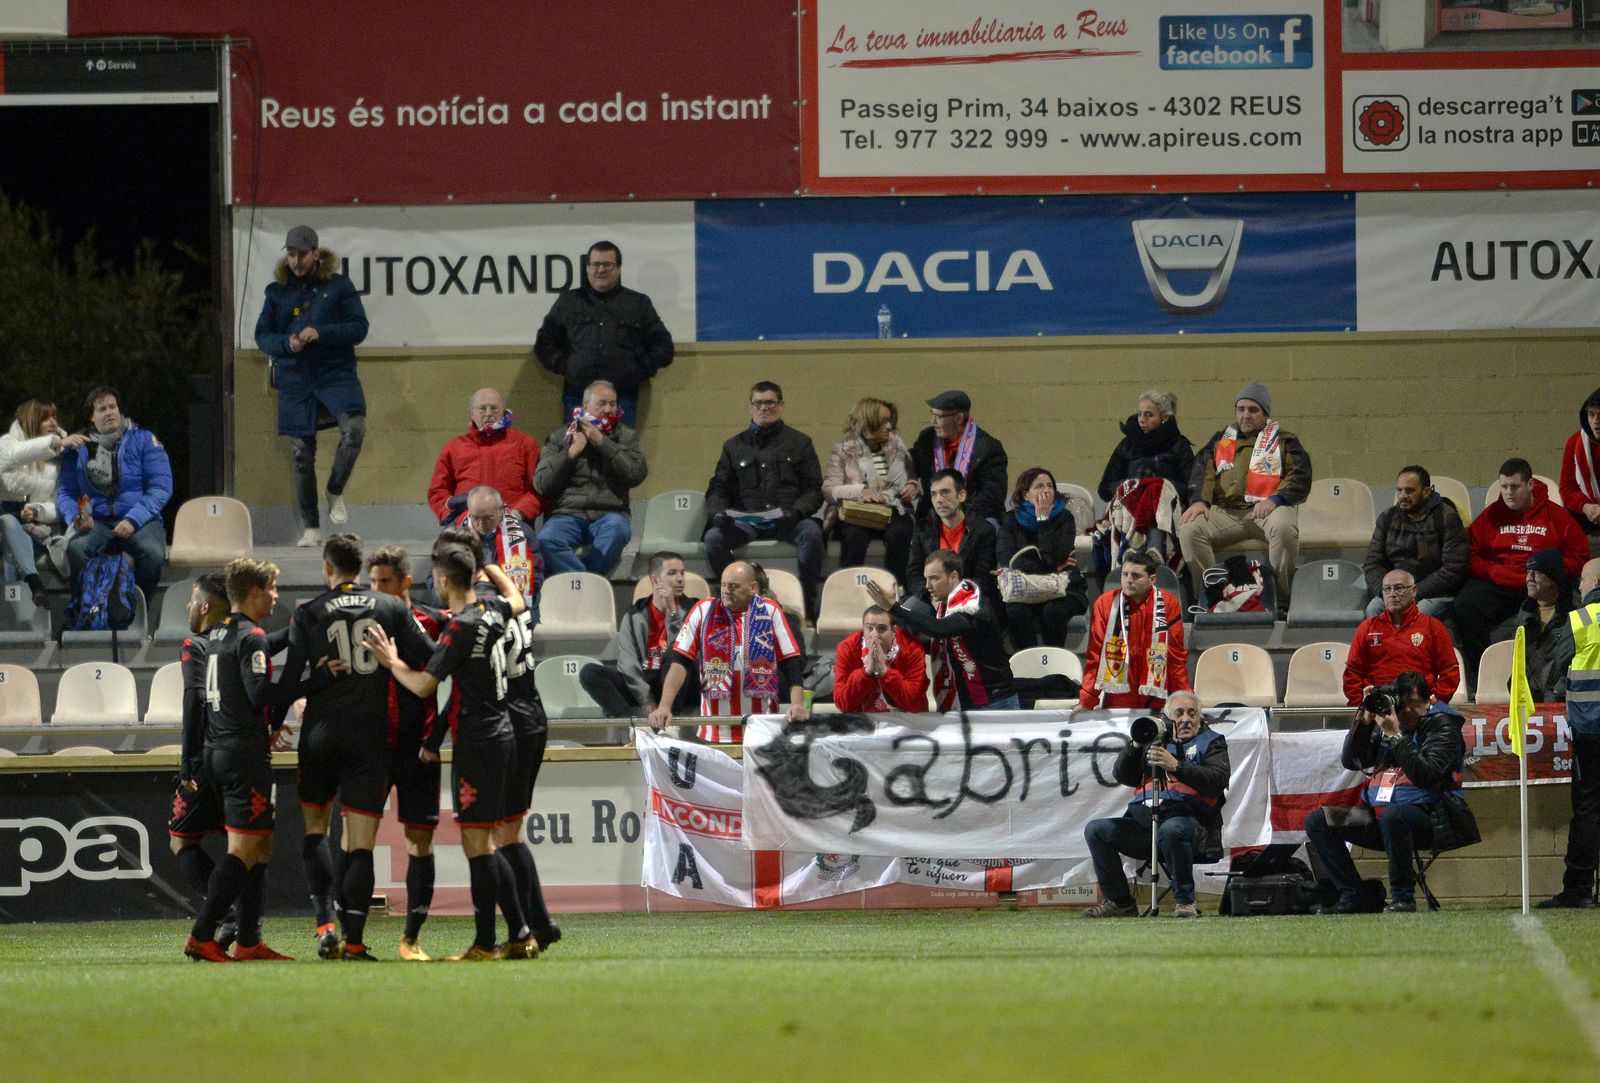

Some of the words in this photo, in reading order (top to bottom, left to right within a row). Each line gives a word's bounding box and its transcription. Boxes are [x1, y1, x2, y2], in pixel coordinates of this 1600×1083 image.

[826, 25, 857, 54] La
[866, 31, 908, 53] teva
[916, 16, 1044, 49] immobiliaria
[1053, 25, 1067, 40] a
[1076, 9, 1128, 40] Reus
[1168, 24, 1206, 41] Like
[1214, 24, 1237, 40] Us
[1243, 24, 1270, 40] On
[1280, 19, 1302, 64] f
[1166, 45, 1272, 65] facebook
[107, 60, 137, 70] Serveis
[261, 98, 336, 129] Reus
[349, 98, 385, 127] és
[397, 96, 509, 126] notícia
[523, 103, 545, 124] a
[558, 92, 648, 123] cada
[661, 93, 771, 121] instant
[840, 98, 938, 122] Passeig
[947, 98, 1011, 120] Prim,
[1020, 98, 1048, 117] 34
[1057, 97, 1139, 117] baixos
[1163, 96, 1222, 116] 4302
[1230, 95, 1302, 115] REUS
[840, 130, 882, 149] Tel.
[895, 129, 938, 149] 977
[950, 129, 993, 148] 322
[1005, 128, 1048, 148] 999
[1080, 127, 1302, 151] www.apireus.com
[1418, 126, 1436, 144] la
[1444, 126, 1514, 144] nostra
[1522, 127, 1563, 147] app
[1151, 234, 1224, 248] DACIA
[1431, 240, 1600, 281] AUTOX
[338, 254, 588, 296] UTOXAND
[813, 250, 1053, 293] DACIA
[1333, 485, 1340, 496] 5
[212, 504, 216, 514] 1
[677, 497, 688, 508] 12
[1500, 525, 1547, 536] INNSBRUCK
[856, 575, 867, 585] 10
[1327, 567, 1334, 578] 5
[10, 588, 16, 599] 3
[570, 579, 581, 590] 13
[325, 595, 376, 613] ATIENZA
[326, 618, 379, 675] 18
[504, 610, 535, 678] 25
[1041, 655, 1048, 665] 8
[1232, 651, 1239, 662] 6
[1325, 650, 1332, 660] 5
[95, 669, 102, 680] 2
[566, 663, 576, 673] 13
[206, 654, 221, 712] 4
[668, 746, 698, 790] U
[755, 711, 1131, 835] Gabrie
[526, 811, 573, 846] eu
[592, 800, 648, 844] Ro
[671, 843, 703, 890] A
[1061, 886, 1076, 895] Creu
[1078, 886, 1094, 896] Roja
